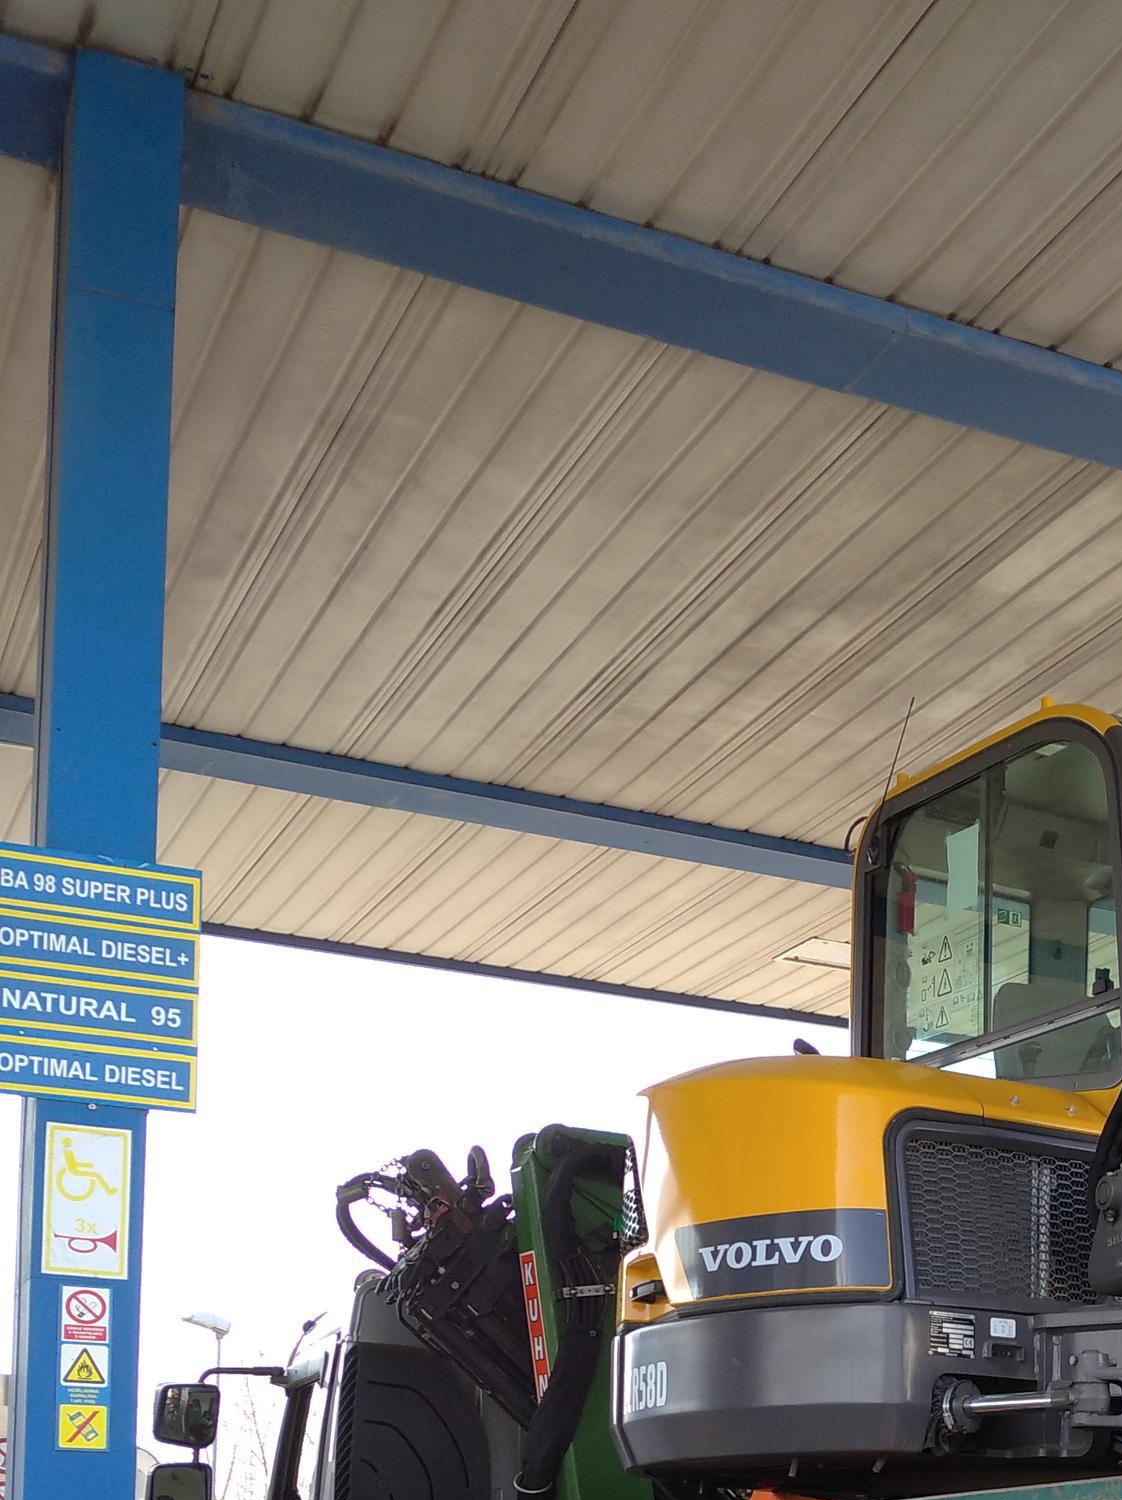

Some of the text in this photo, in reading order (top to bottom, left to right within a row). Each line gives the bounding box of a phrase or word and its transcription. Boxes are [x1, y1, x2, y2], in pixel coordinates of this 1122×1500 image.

[0, 868, 188, 912] BA 98 SUPER PLUS
[0, 926, 189, 968] OPTIMAL DIESEL+
[2, 987, 182, 1028] NATURAL 95
[0, 1053, 184, 1091] OPTIMAL DIESEL
[699, 1233, 843, 1272] VOLVO
[524, 1261, 549, 1398] KUHN
[624, 1361, 668, 1414] R58D
